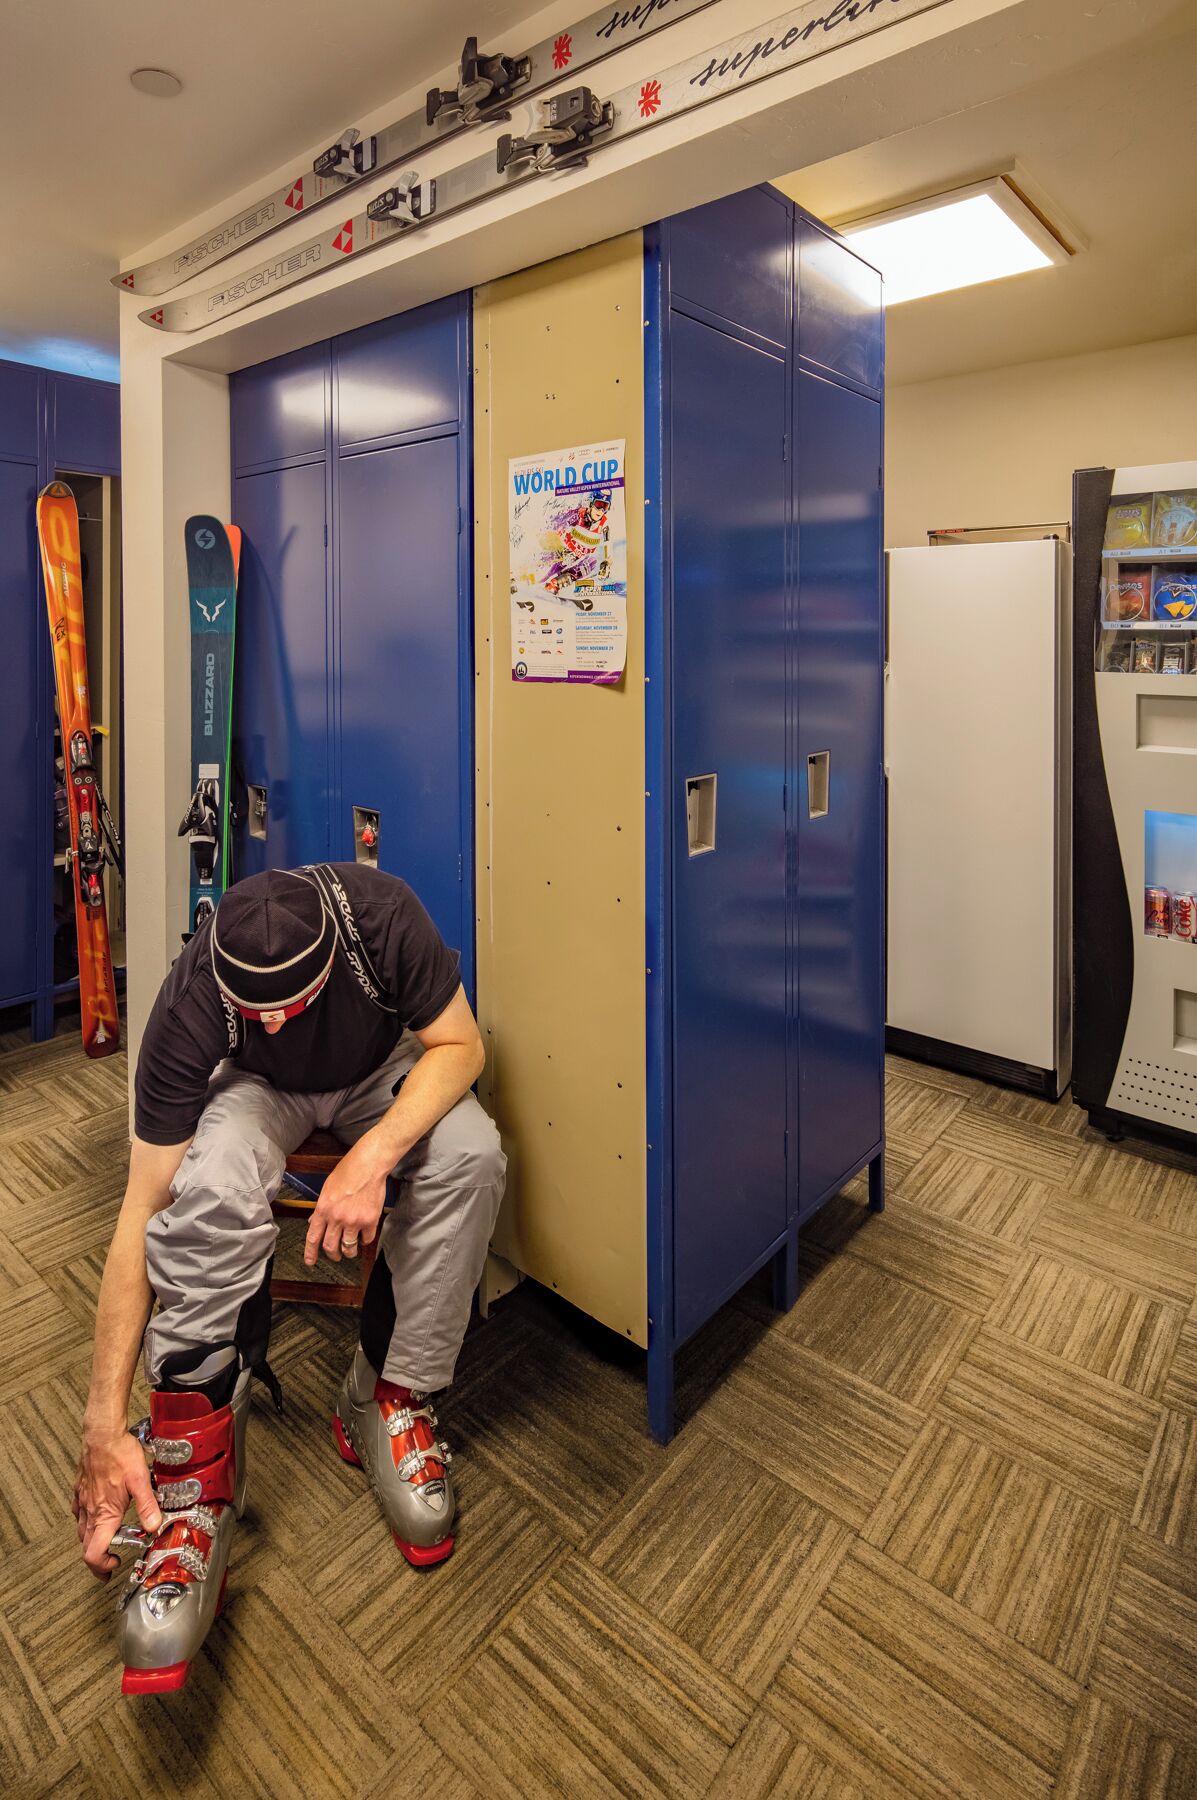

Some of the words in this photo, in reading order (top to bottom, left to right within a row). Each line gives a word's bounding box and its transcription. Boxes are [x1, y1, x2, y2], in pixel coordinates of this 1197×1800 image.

[596, 0, 678, 38] sup
[689, 0, 900, 87] superli
[173, 202, 276, 274] FISCHER
[207, 244, 321, 312] FISCHER
[513, 466, 577, 496] WORLD
[581, 459, 619, 484] CUP
[204, 652, 215, 736] BLIZZARD
[332, 882, 363, 942] SPYDER
[1176, 899, 1192, 938] Coke
[346, 951, 379, 1000] SPYDER
[220, 993, 239, 1049] SPYDER
